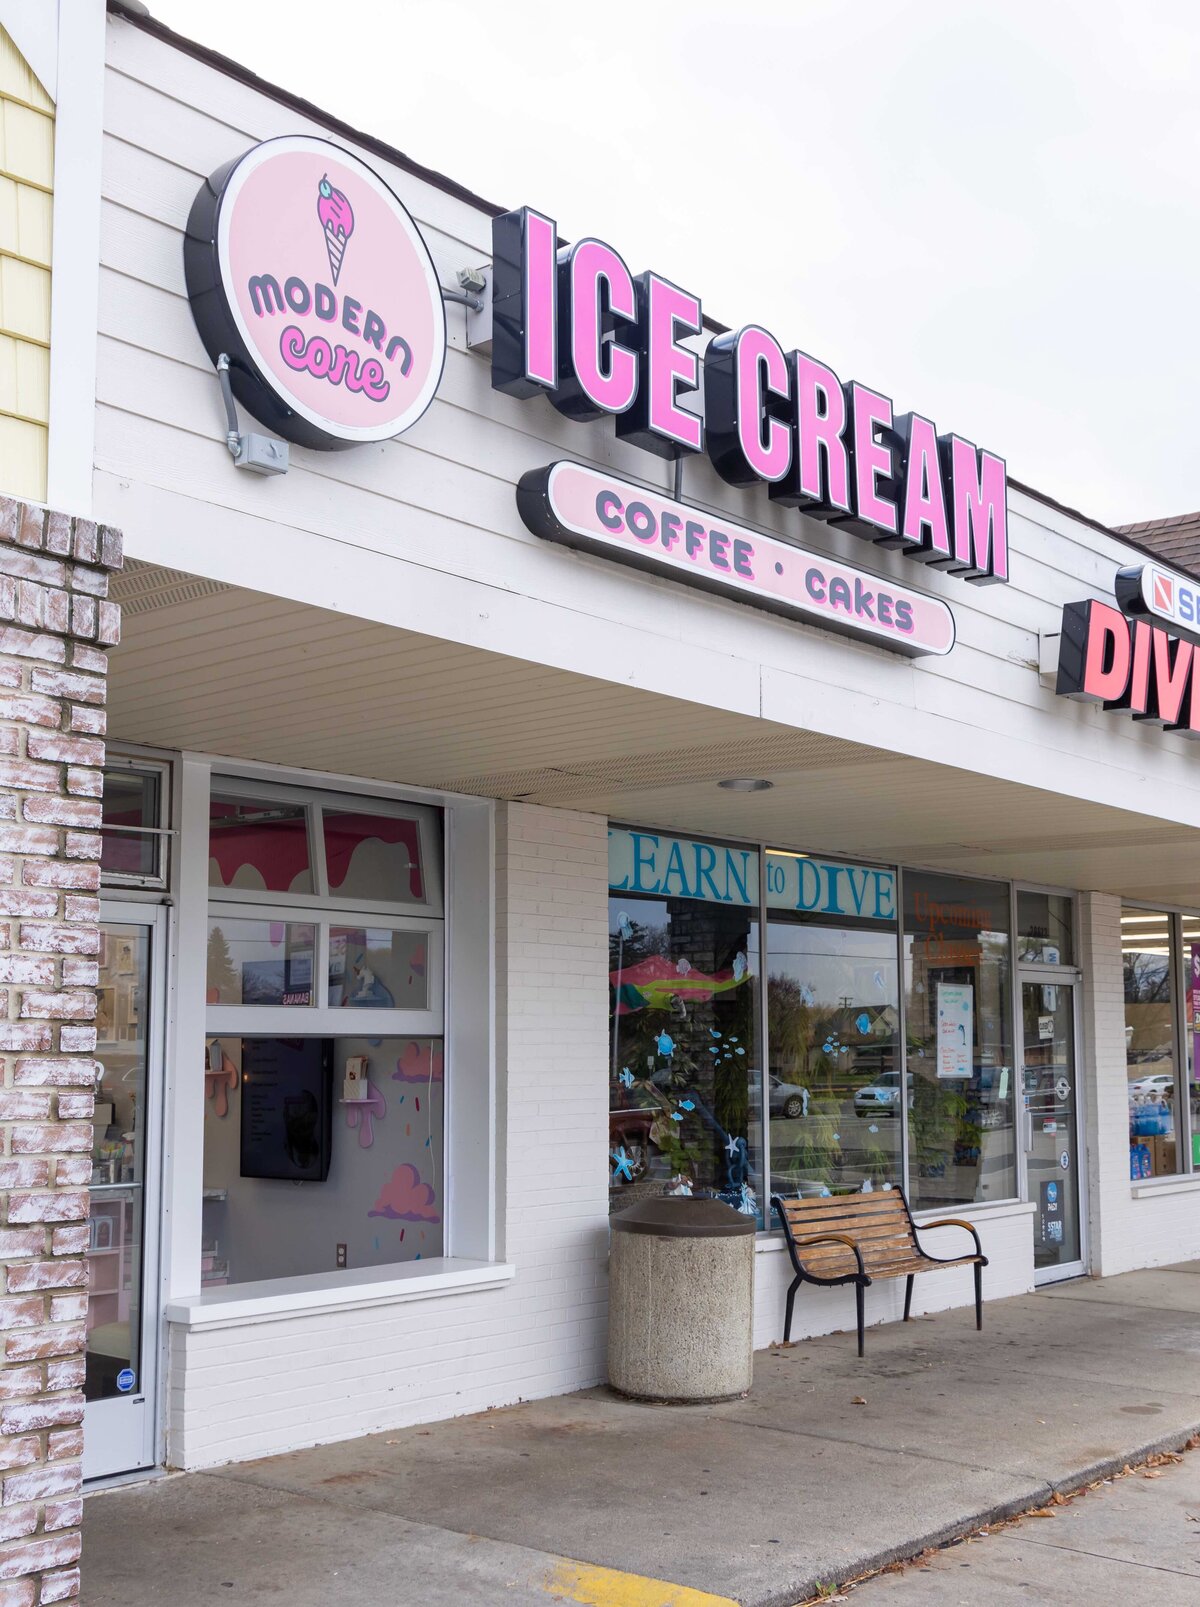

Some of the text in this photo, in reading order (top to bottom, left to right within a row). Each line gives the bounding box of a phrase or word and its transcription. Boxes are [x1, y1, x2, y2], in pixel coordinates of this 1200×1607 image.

[248, 273, 414, 378] MODERN
[523, 206, 1009, 583] ICE CREAM
[595, 490, 755, 580] COFFEE
[767, 860, 785, 894] to
[796, 857, 895, 919] DIVE
[912, 891, 993, 937] Upcoming
